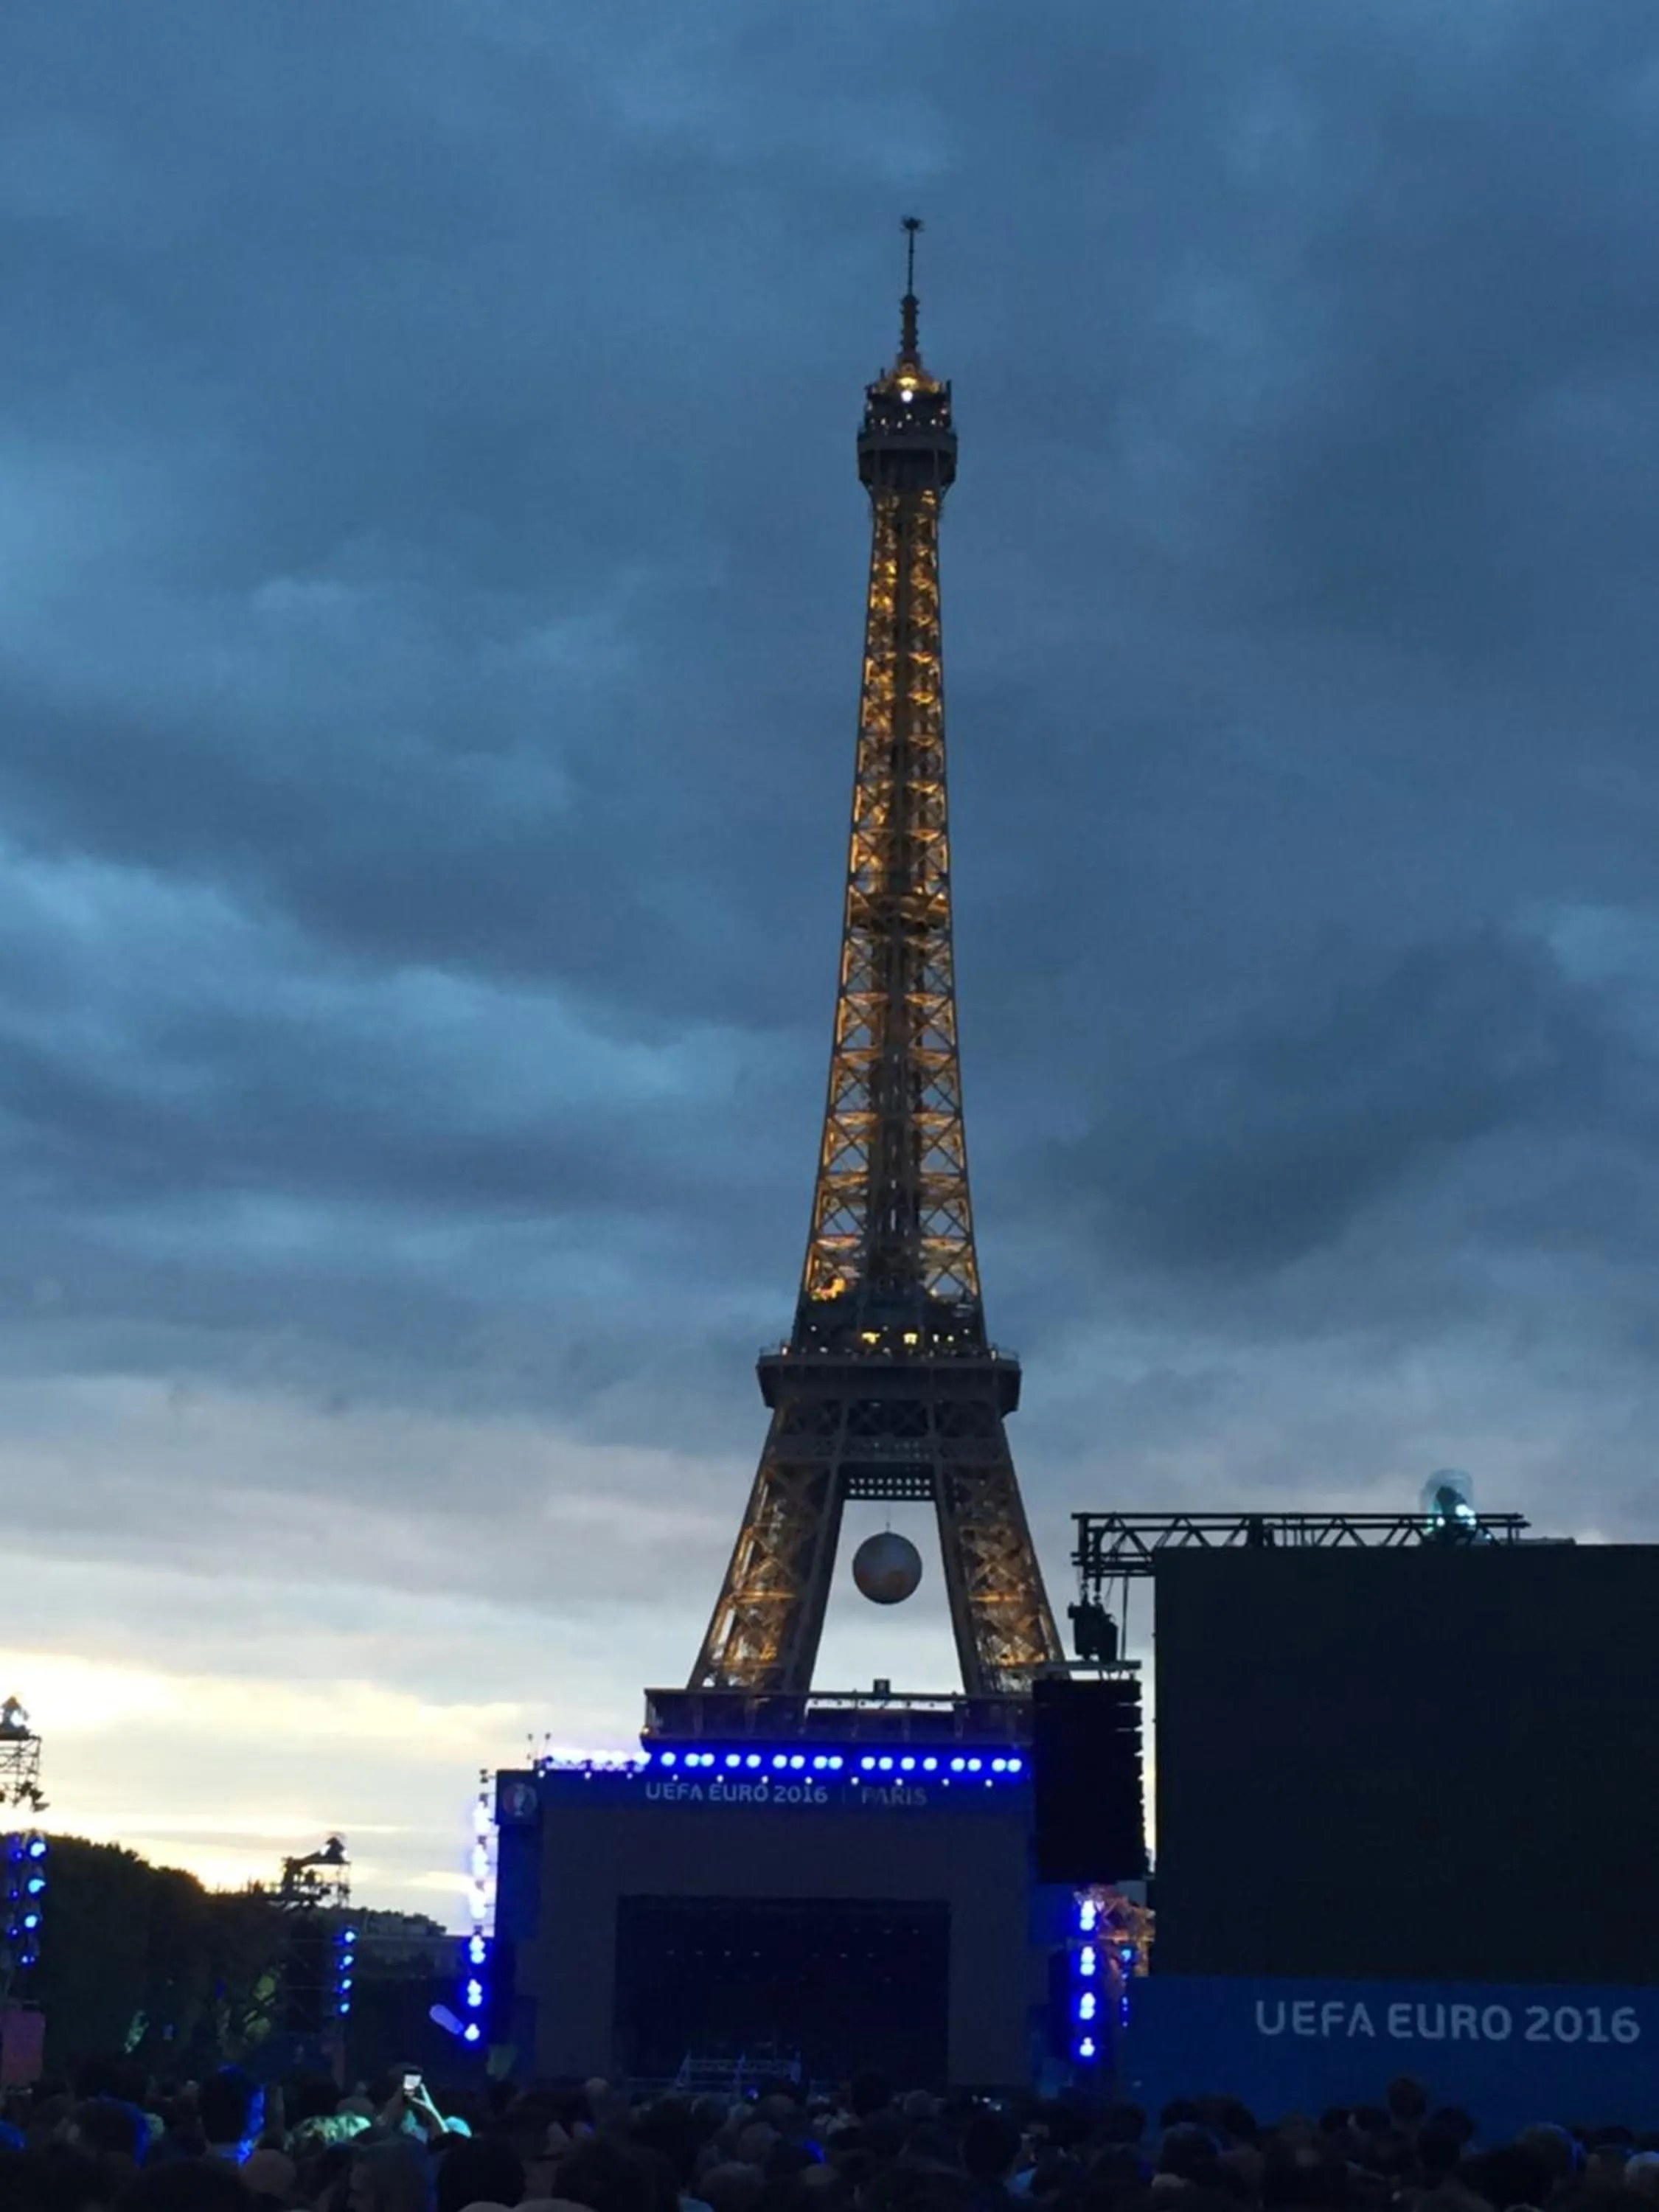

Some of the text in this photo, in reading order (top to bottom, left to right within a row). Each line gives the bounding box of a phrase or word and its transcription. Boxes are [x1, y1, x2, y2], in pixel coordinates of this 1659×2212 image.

[645, 1781, 928, 1806] UEFA EURO 2016 PARIS
[1255, 2000, 1641, 2044] UEFA EURO 2016
